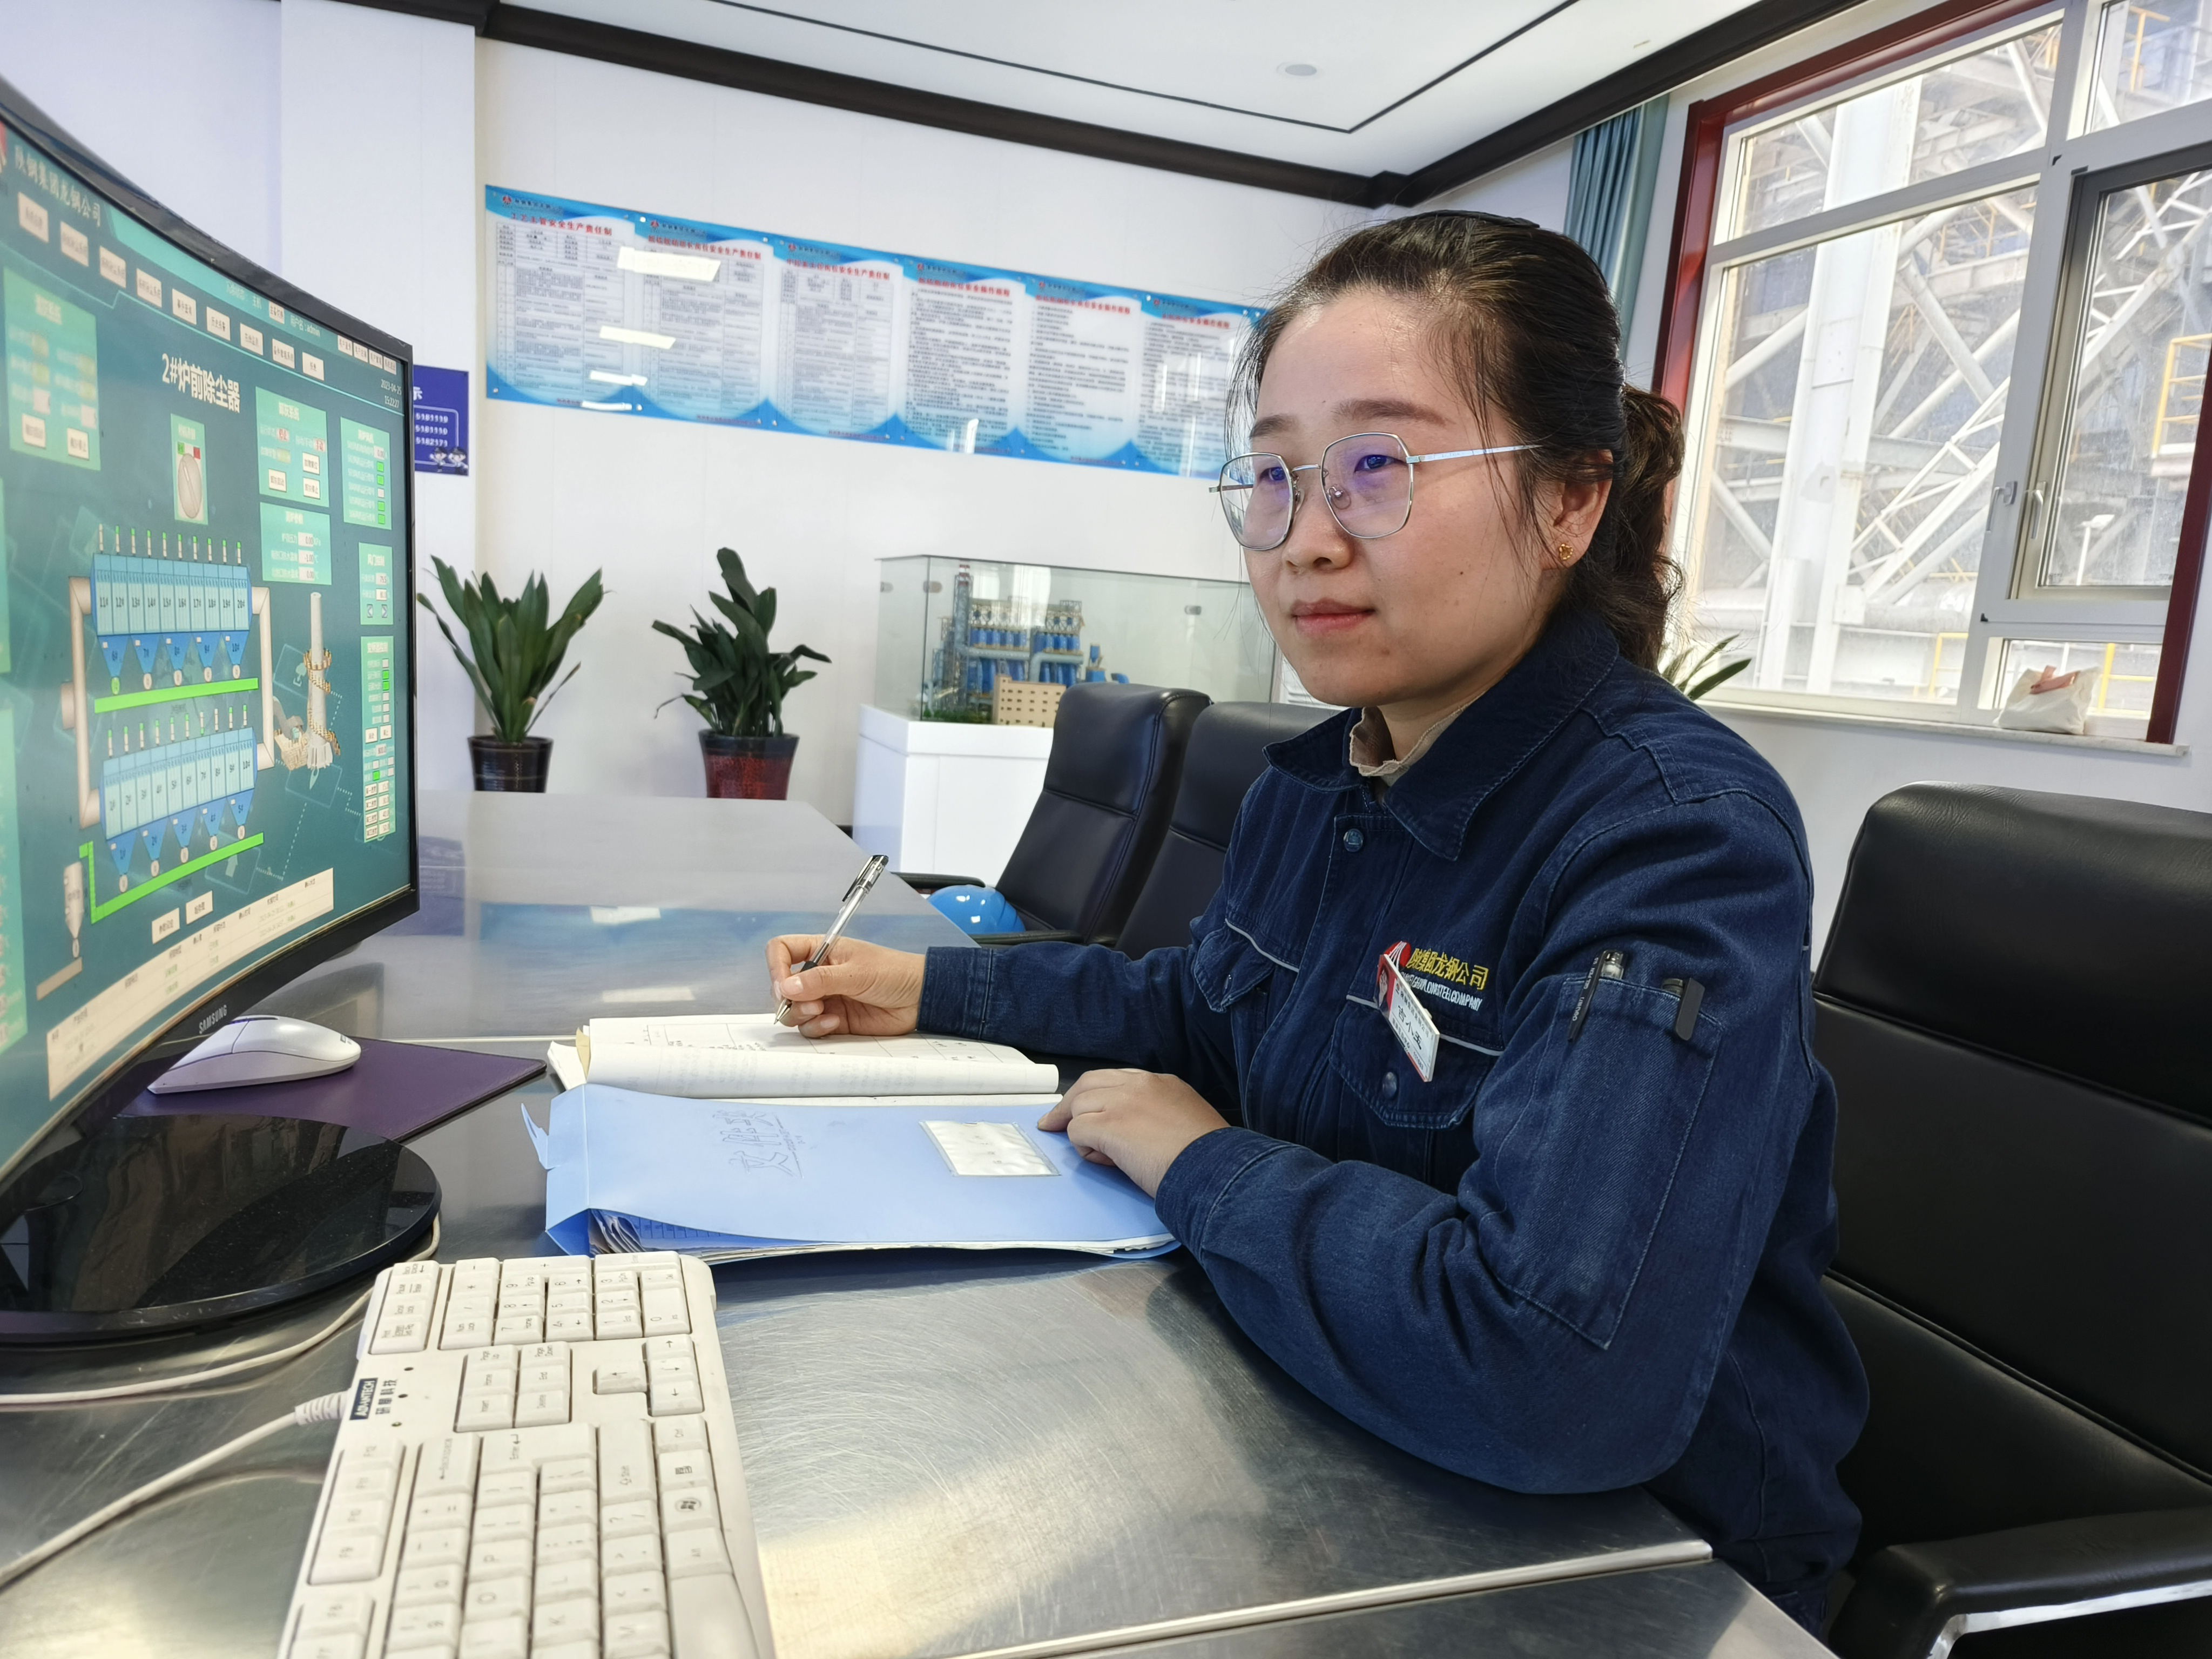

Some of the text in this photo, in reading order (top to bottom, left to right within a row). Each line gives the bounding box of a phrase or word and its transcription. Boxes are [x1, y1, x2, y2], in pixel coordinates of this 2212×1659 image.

[162, 353, 240, 414] 2#炉前除尘器
[199, 1004, 227, 1034] SAMSUNG
[354, 1380, 376, 1417] ADVANTECH
